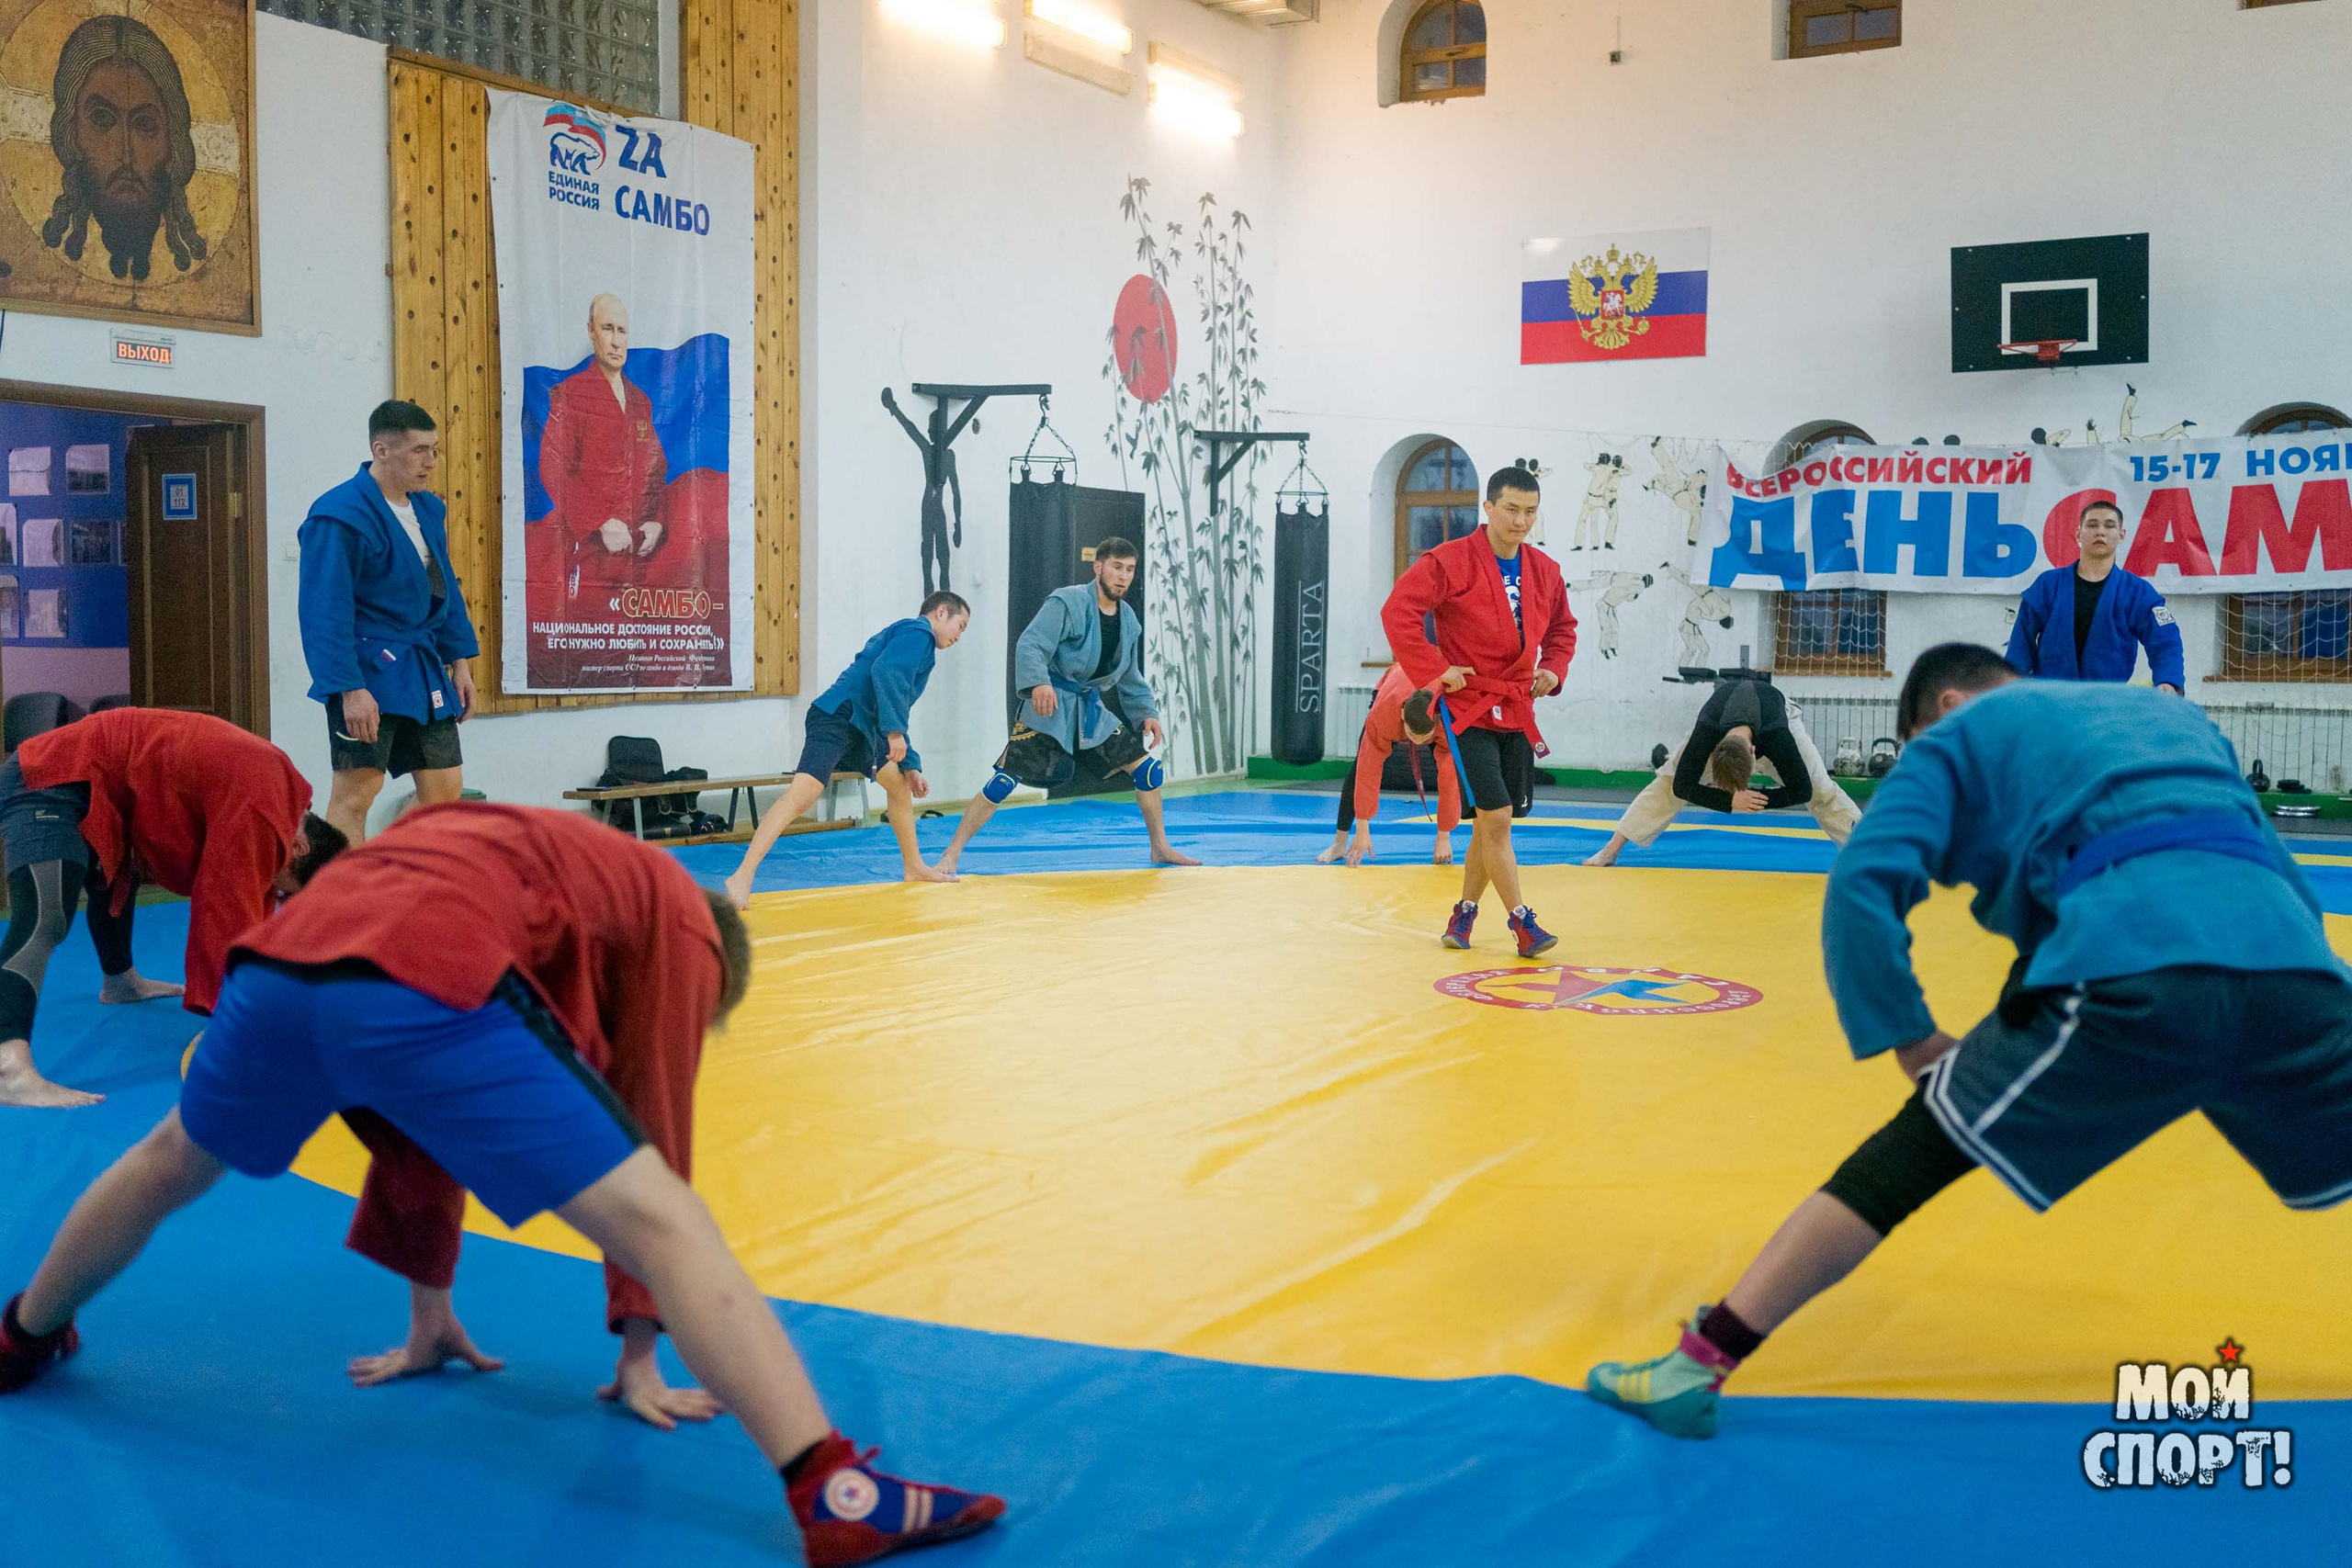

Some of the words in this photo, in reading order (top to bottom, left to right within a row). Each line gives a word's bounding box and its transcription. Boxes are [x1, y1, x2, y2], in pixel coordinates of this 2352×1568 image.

[616, 125, 667, 178] ZA
[548, 171, 600, 195] ЕДИНАЯ
[549, 186, 600, 210] РОССИЯ
[615, 185, 710, 236] САМБО
[118, 343, 170, 364] ВЫХОД
[1726, 450, 2032, 498] ВСЕРОССИЙСКИЙ
[2130, 452, 2222, 482] 15-17
[1709, 489, 2037, 591] ДЕНЬ
[533, 622, 616, 635] НАЦИОНАЛЬНОЕ
[617, 624, 672, 637] ДОСТОЯНИЕ
[548, 637, 568, 649] ЕГО
[569, 638, 606, 649] НУЖНО
[608, 638, 647, 649] ЛЮБИТЬ
[649, 639, 657, 649] И
[1298, 581, 1322, 713] SPARTA
